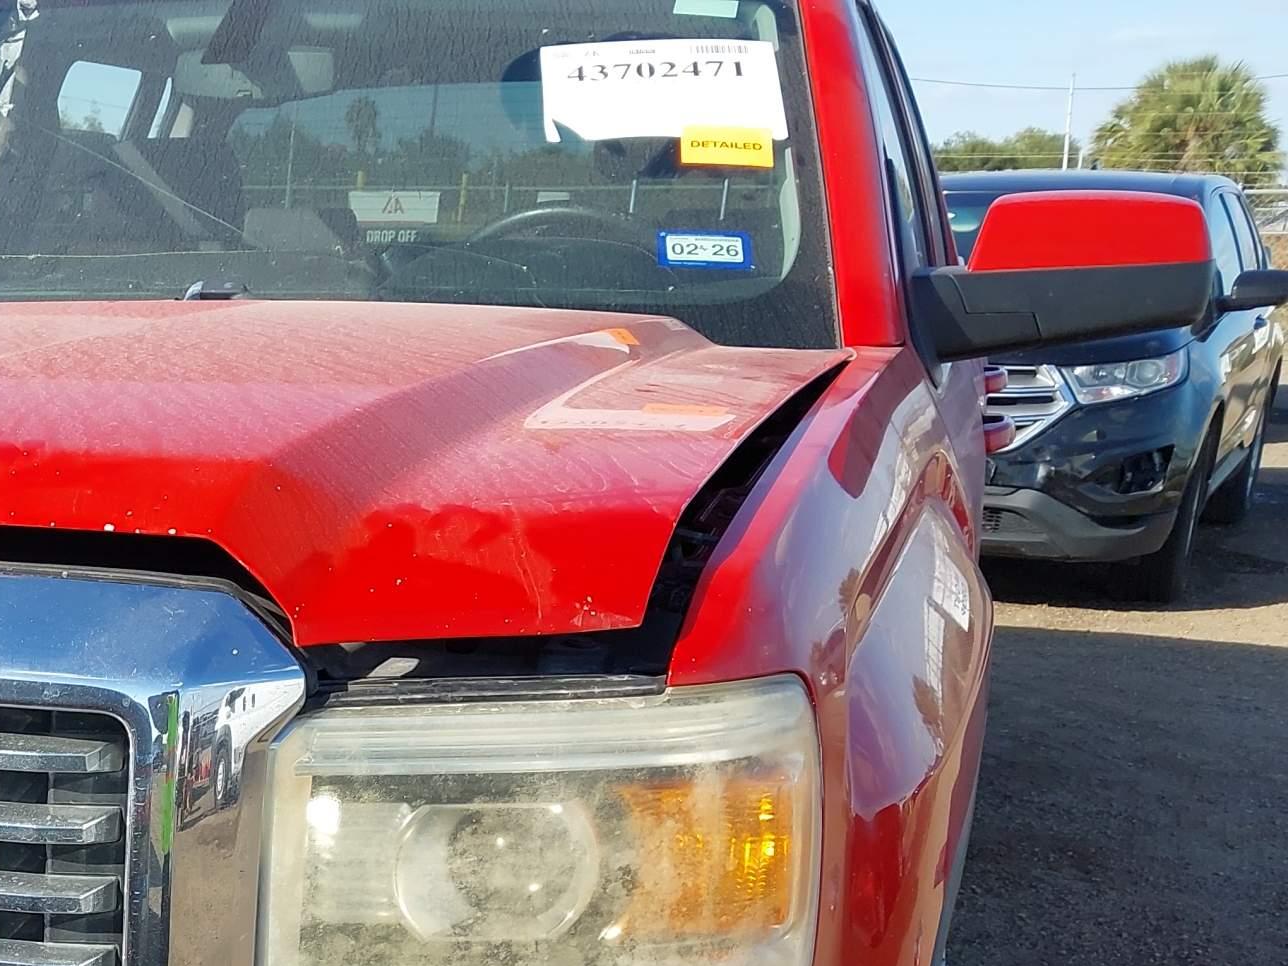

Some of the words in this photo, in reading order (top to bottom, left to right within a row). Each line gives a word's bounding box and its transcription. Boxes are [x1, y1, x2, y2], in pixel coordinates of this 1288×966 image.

[568, 61, 743, 81] 43702471
[690, 140, 763, 151] DETAILED
[366, 230, 396, 243] DROP
[397, 230, 418, 243] OFF
[671, 243, 699, 256] 02
[711, 244, 739, 257] 26
